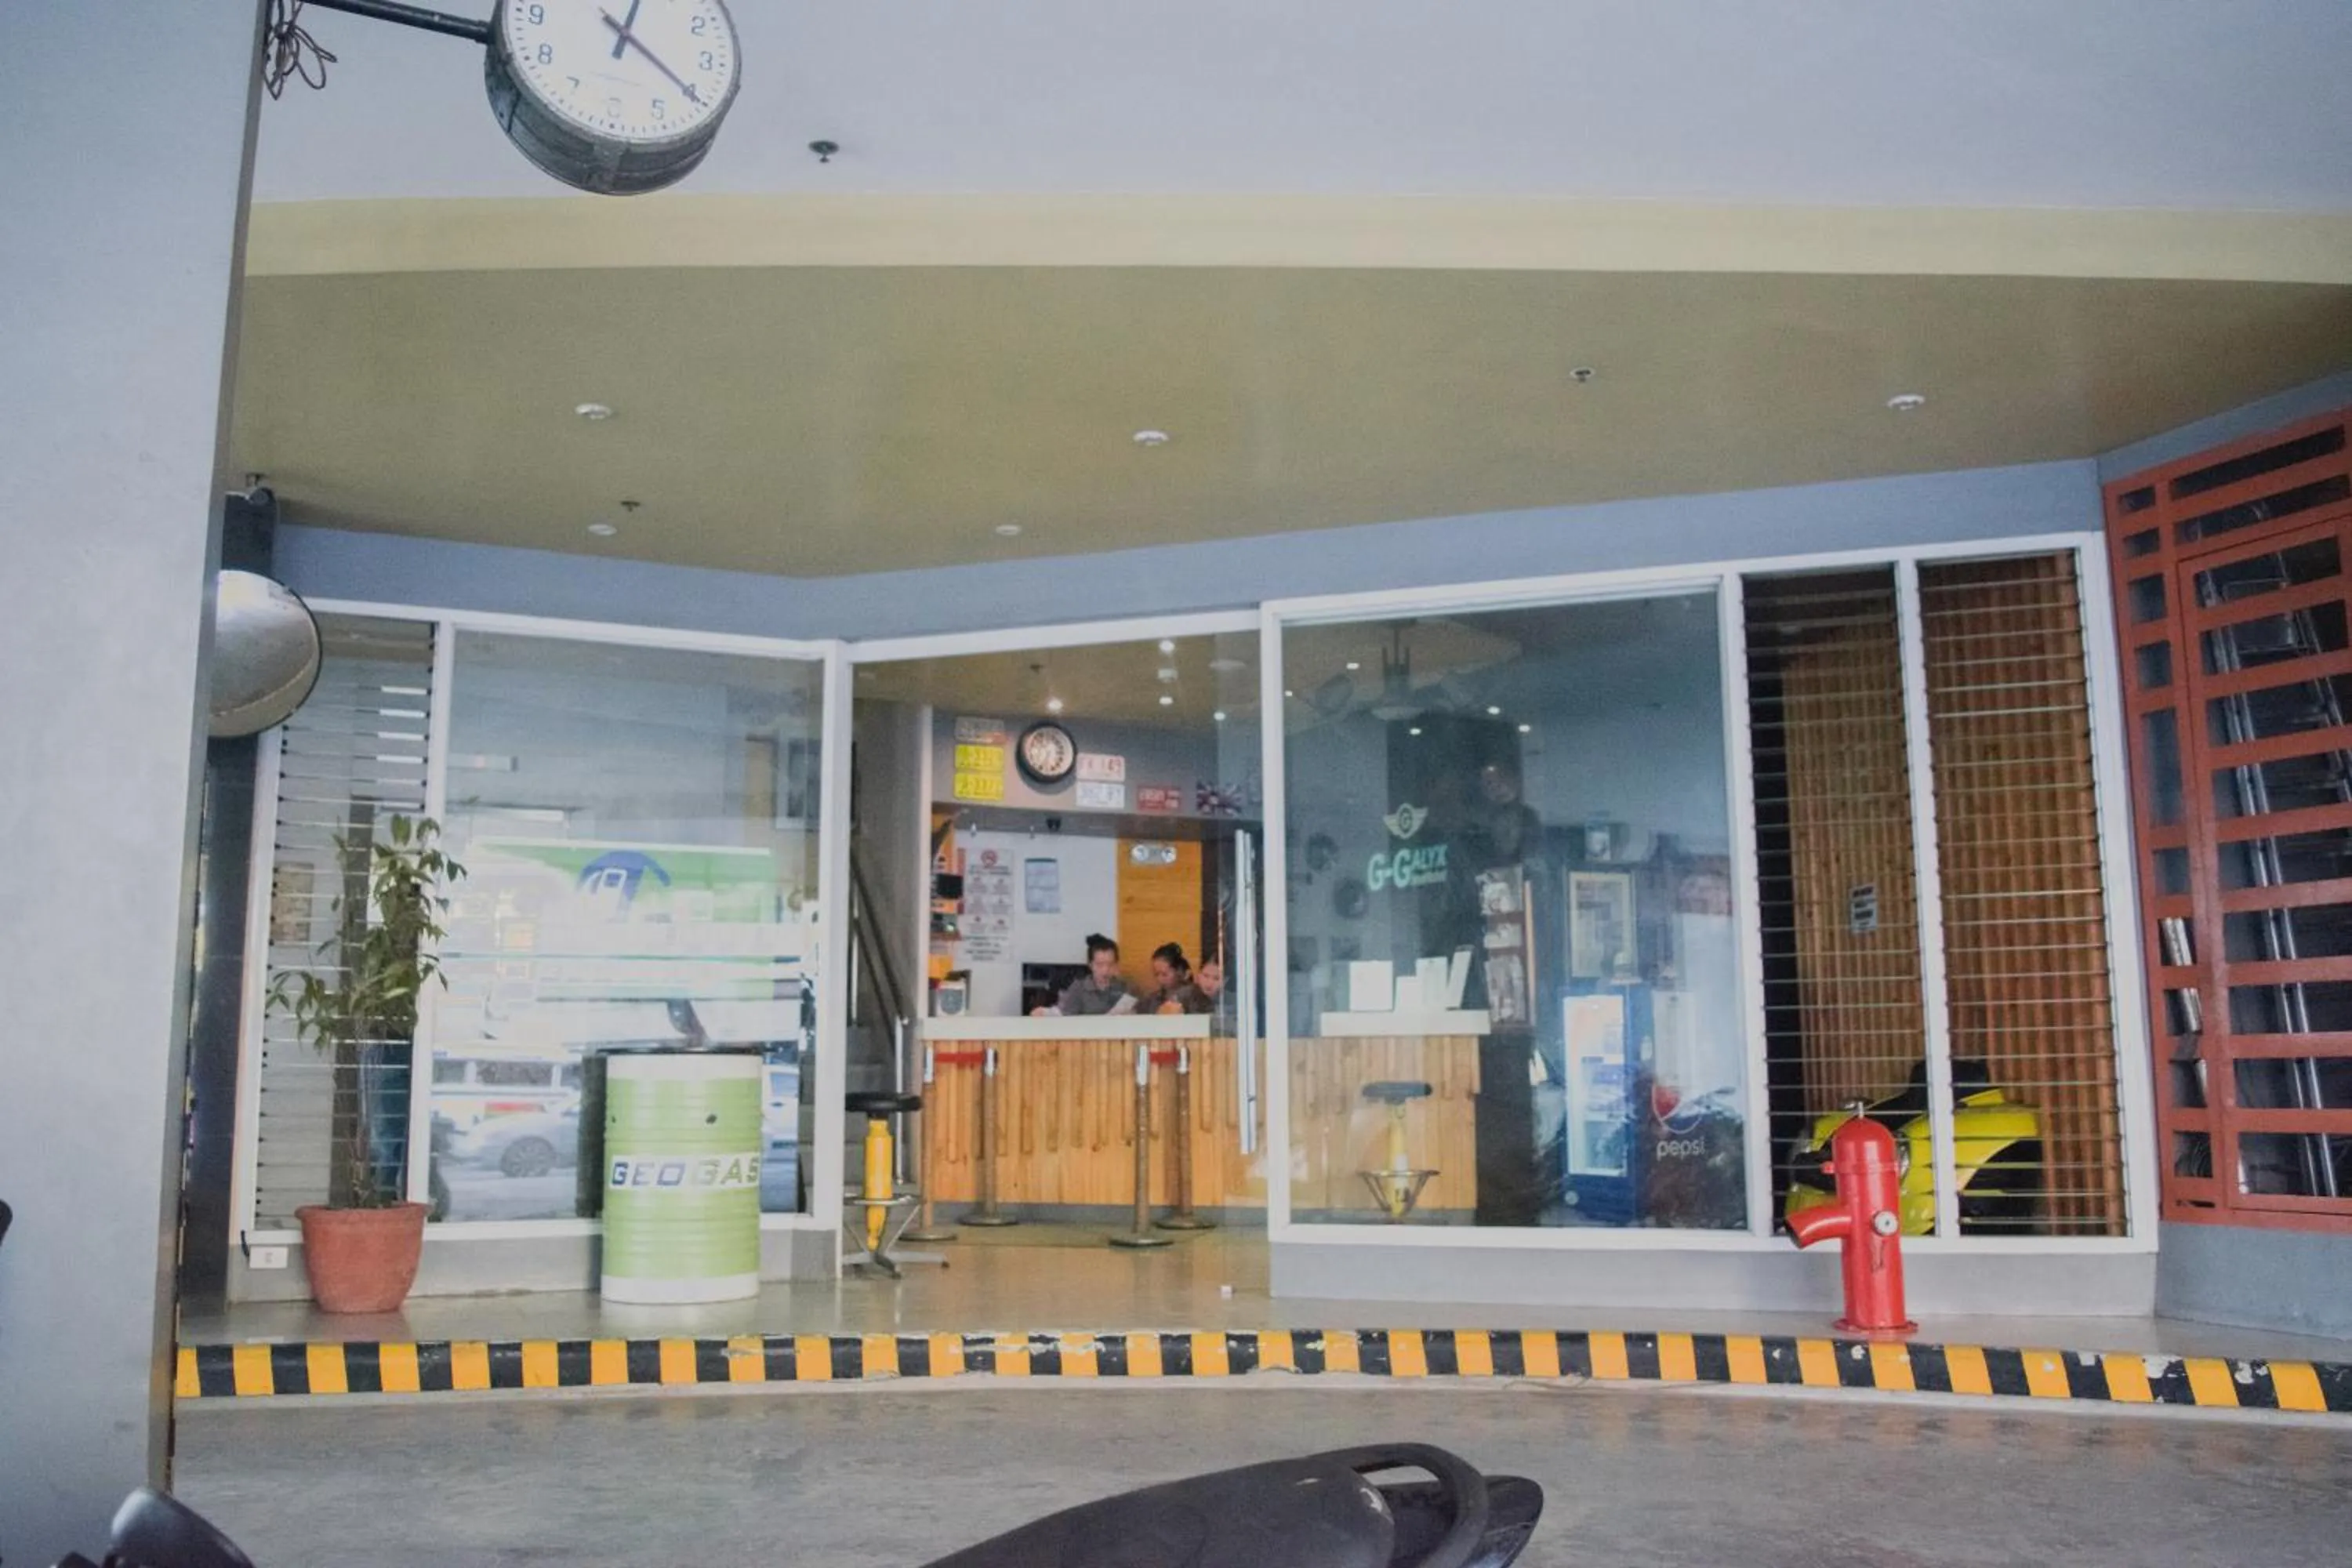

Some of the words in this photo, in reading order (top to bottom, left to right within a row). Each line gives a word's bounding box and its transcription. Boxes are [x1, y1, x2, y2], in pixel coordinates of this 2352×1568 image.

[528, 4, 544, 26] 9
[690, 16, 706, 36] 2
[537, 43, 554, 65] 8
[699, 50, 713, 71] 3
[651, 97, 666, 121] 5
[1656, 1135, 1706, 1162] pepsi
[611, 1161, 686, 1187] GEO
[691, 1156, 760, 1186] GAS
